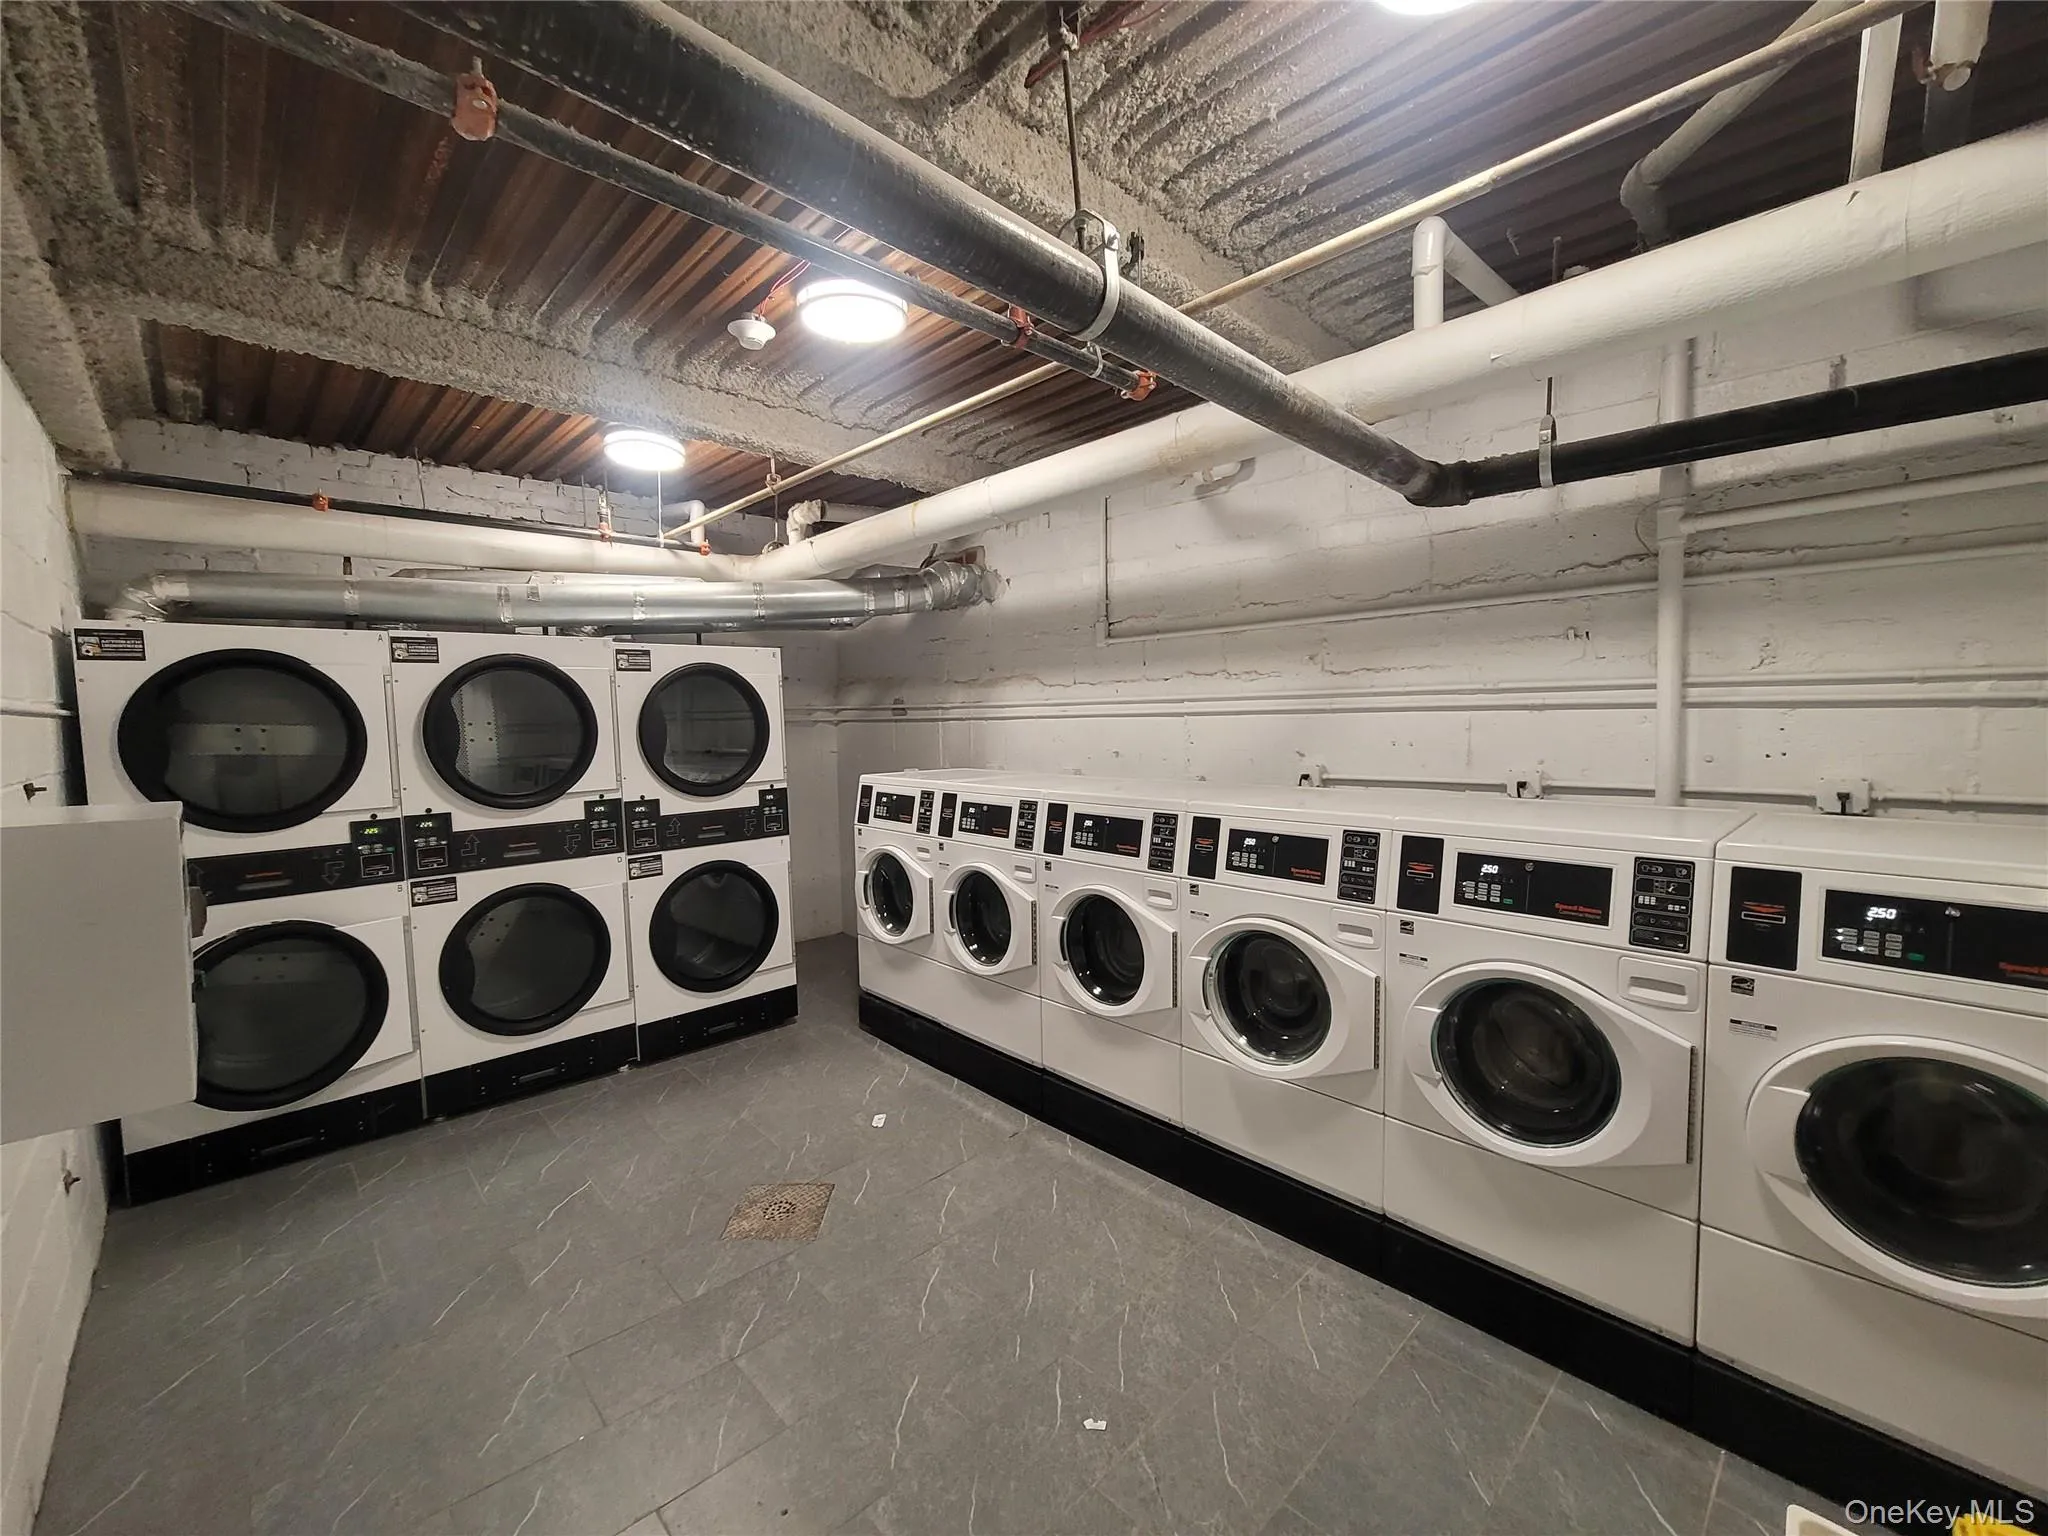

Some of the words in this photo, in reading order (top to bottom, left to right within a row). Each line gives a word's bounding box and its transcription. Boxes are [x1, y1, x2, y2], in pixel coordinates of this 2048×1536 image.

[364, 827, 379, 835] 225
[1480, 863, 1499, 874] 250
[1866, 906, 1897, 920] 250
